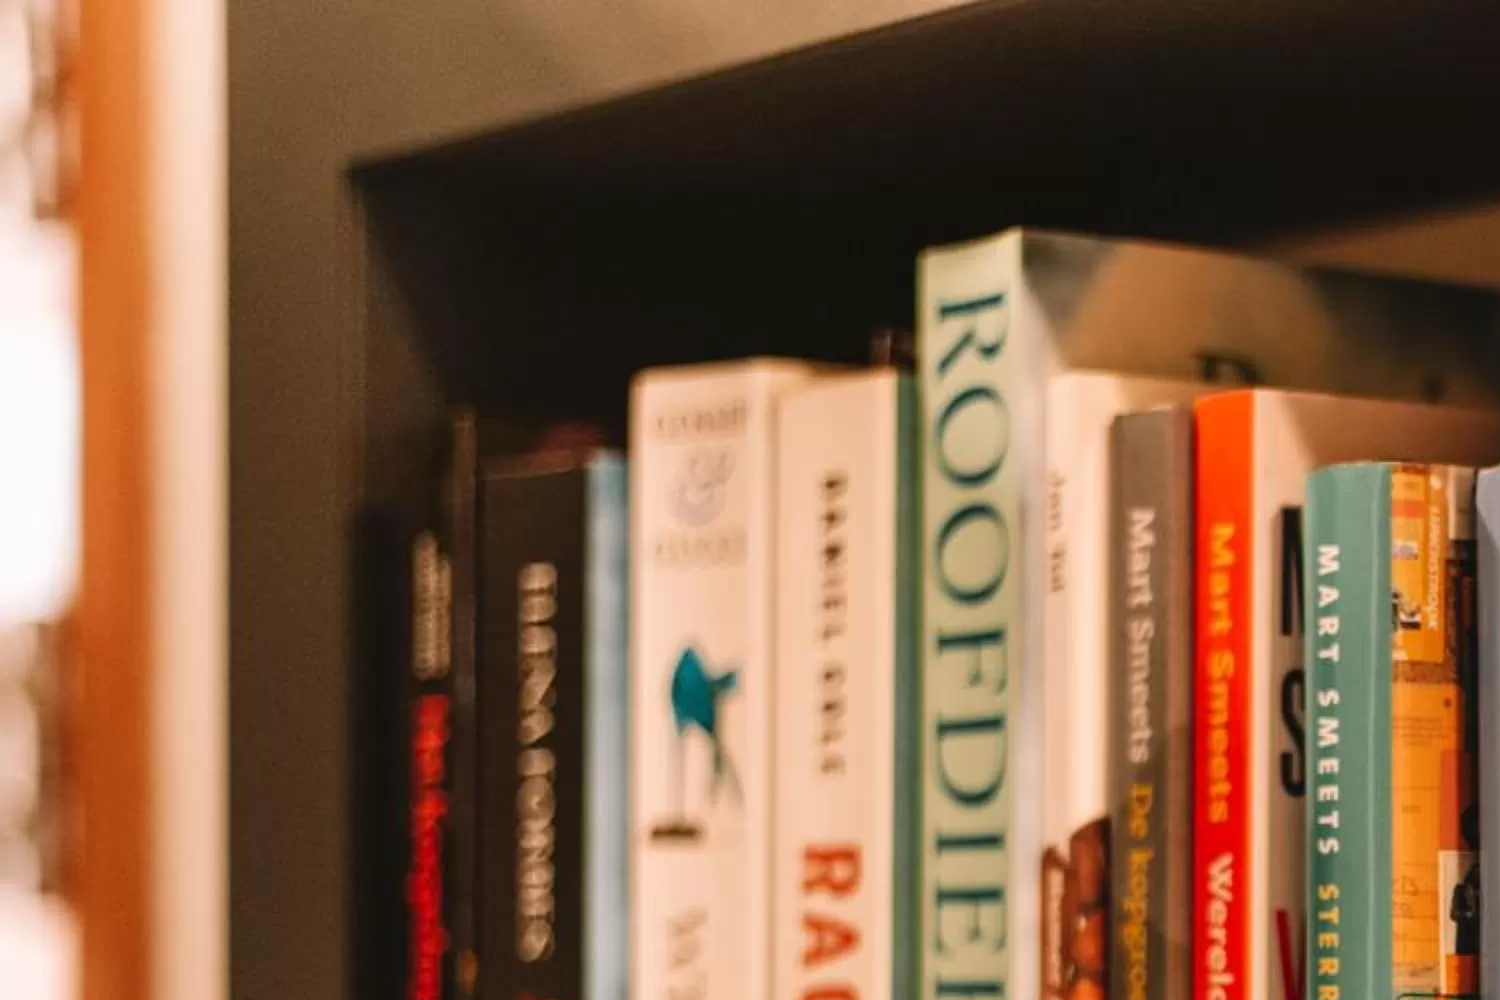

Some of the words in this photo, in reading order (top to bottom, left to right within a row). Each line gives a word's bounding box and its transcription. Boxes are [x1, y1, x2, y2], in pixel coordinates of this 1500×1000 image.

[1125, 507, 1156, 609] Mart
[1207, 521, 1237, 636] Mart
[1315, 544, 1341, 664] MART
[1125, 618, 1156, 763] Smeets
[1205, 651, 1236, 825] Smeets
[1122, 782, 1155, 838] De
[1315, 689, 1341, 855] SMEETS
